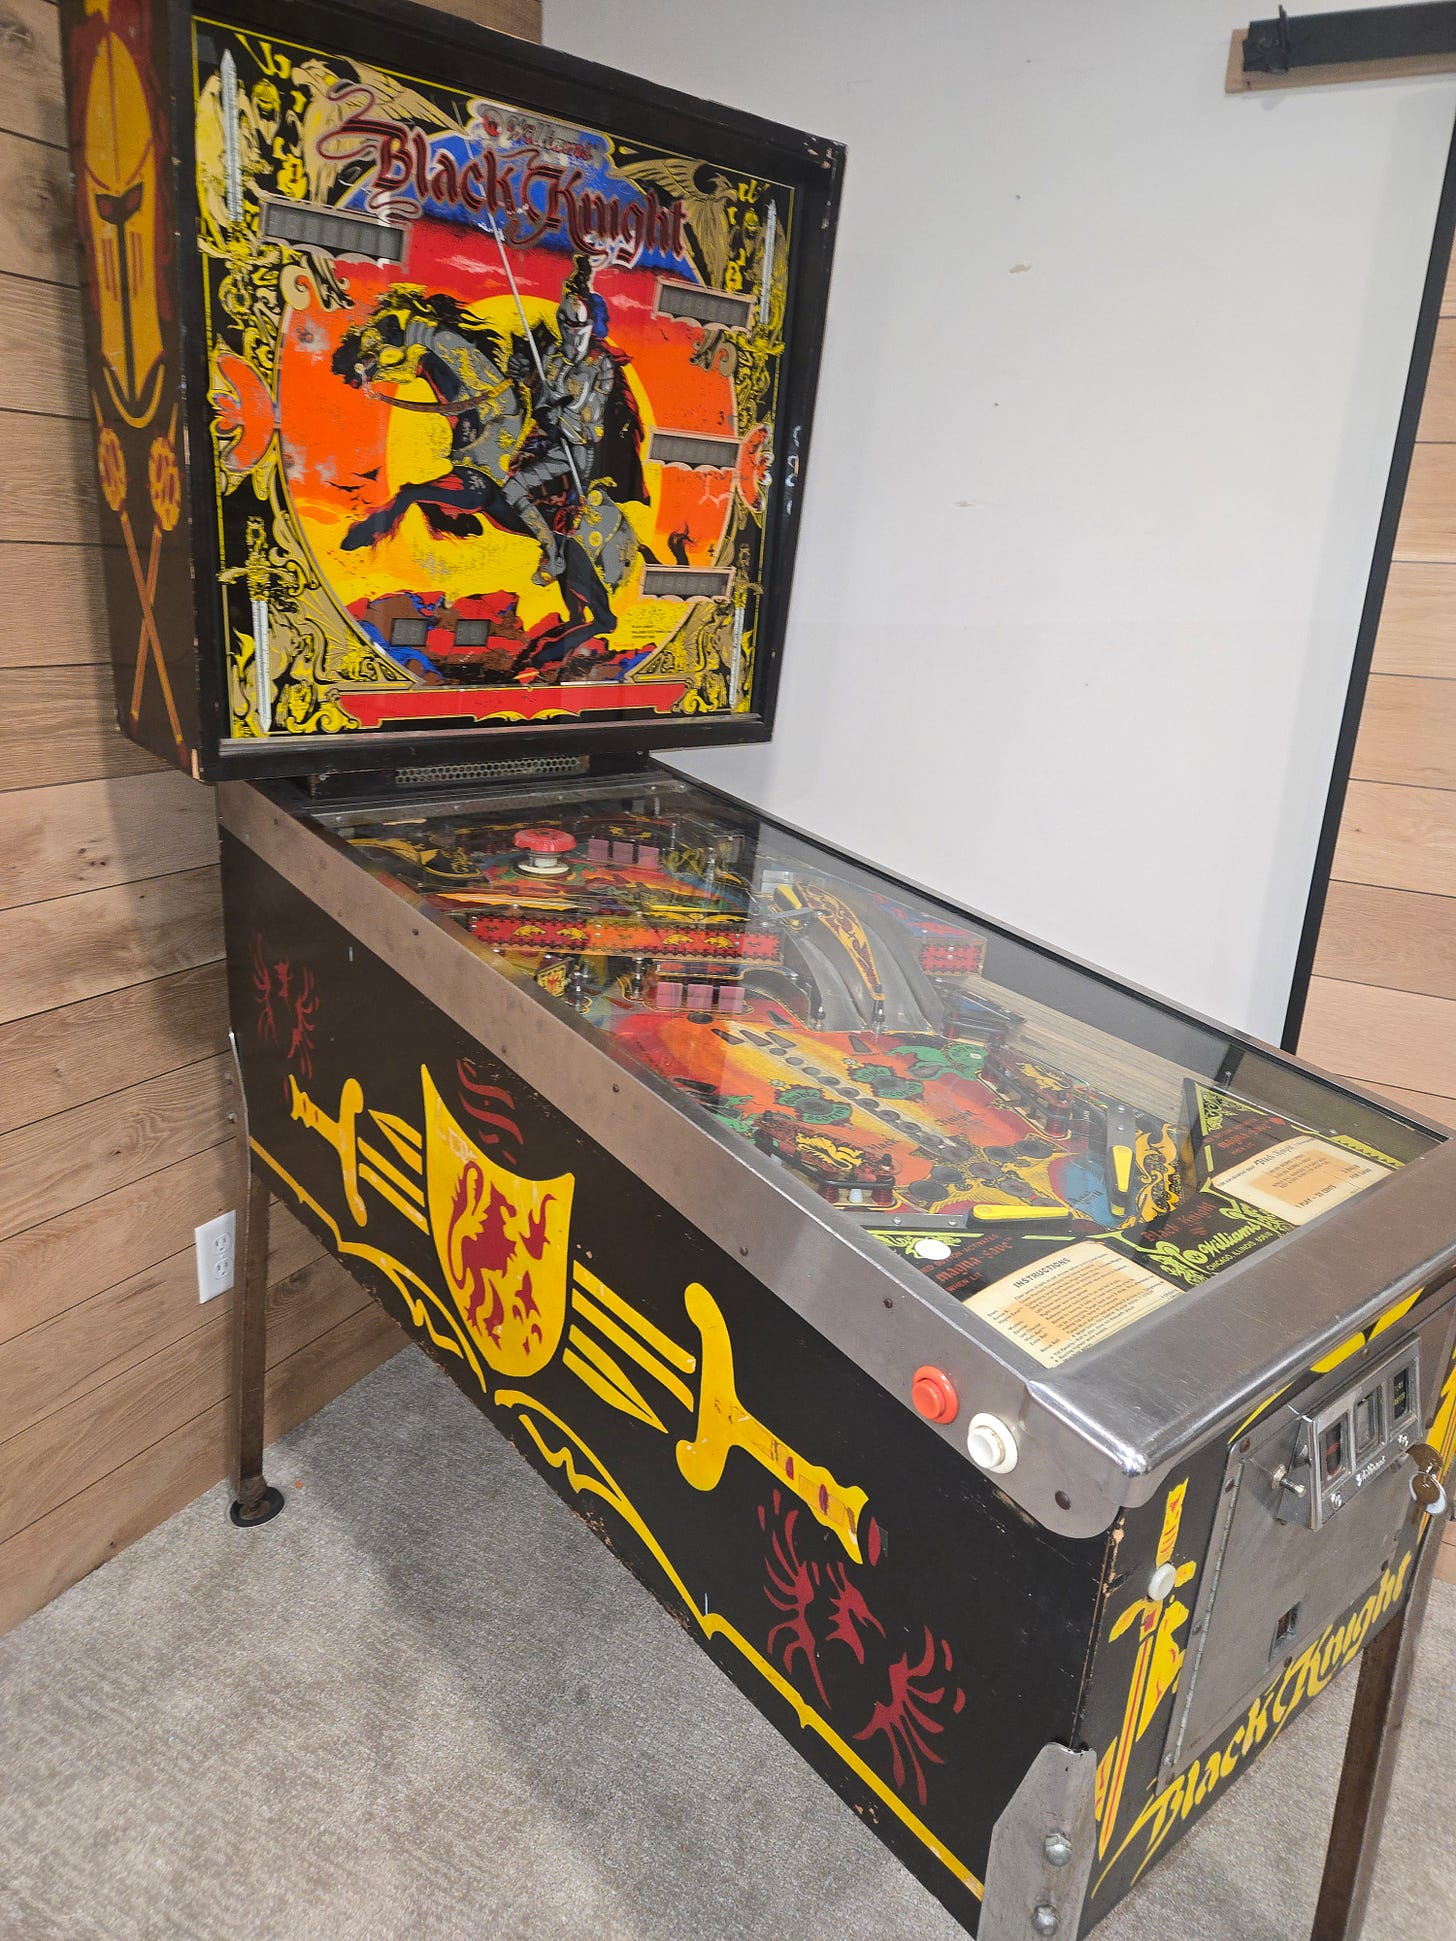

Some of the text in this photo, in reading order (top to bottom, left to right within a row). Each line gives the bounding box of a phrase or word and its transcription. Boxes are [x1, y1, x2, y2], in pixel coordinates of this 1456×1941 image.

[316, 84, 687, 268] Black Knight
[1197, 1220, 1263, 1257] Williams
[945, 1271, 984, 1292] WHEN LIT
[1012, 1257, 1071, 1288] INSTRUCTIONS
[1091, 1550, 1412, 1899] Black Knight
